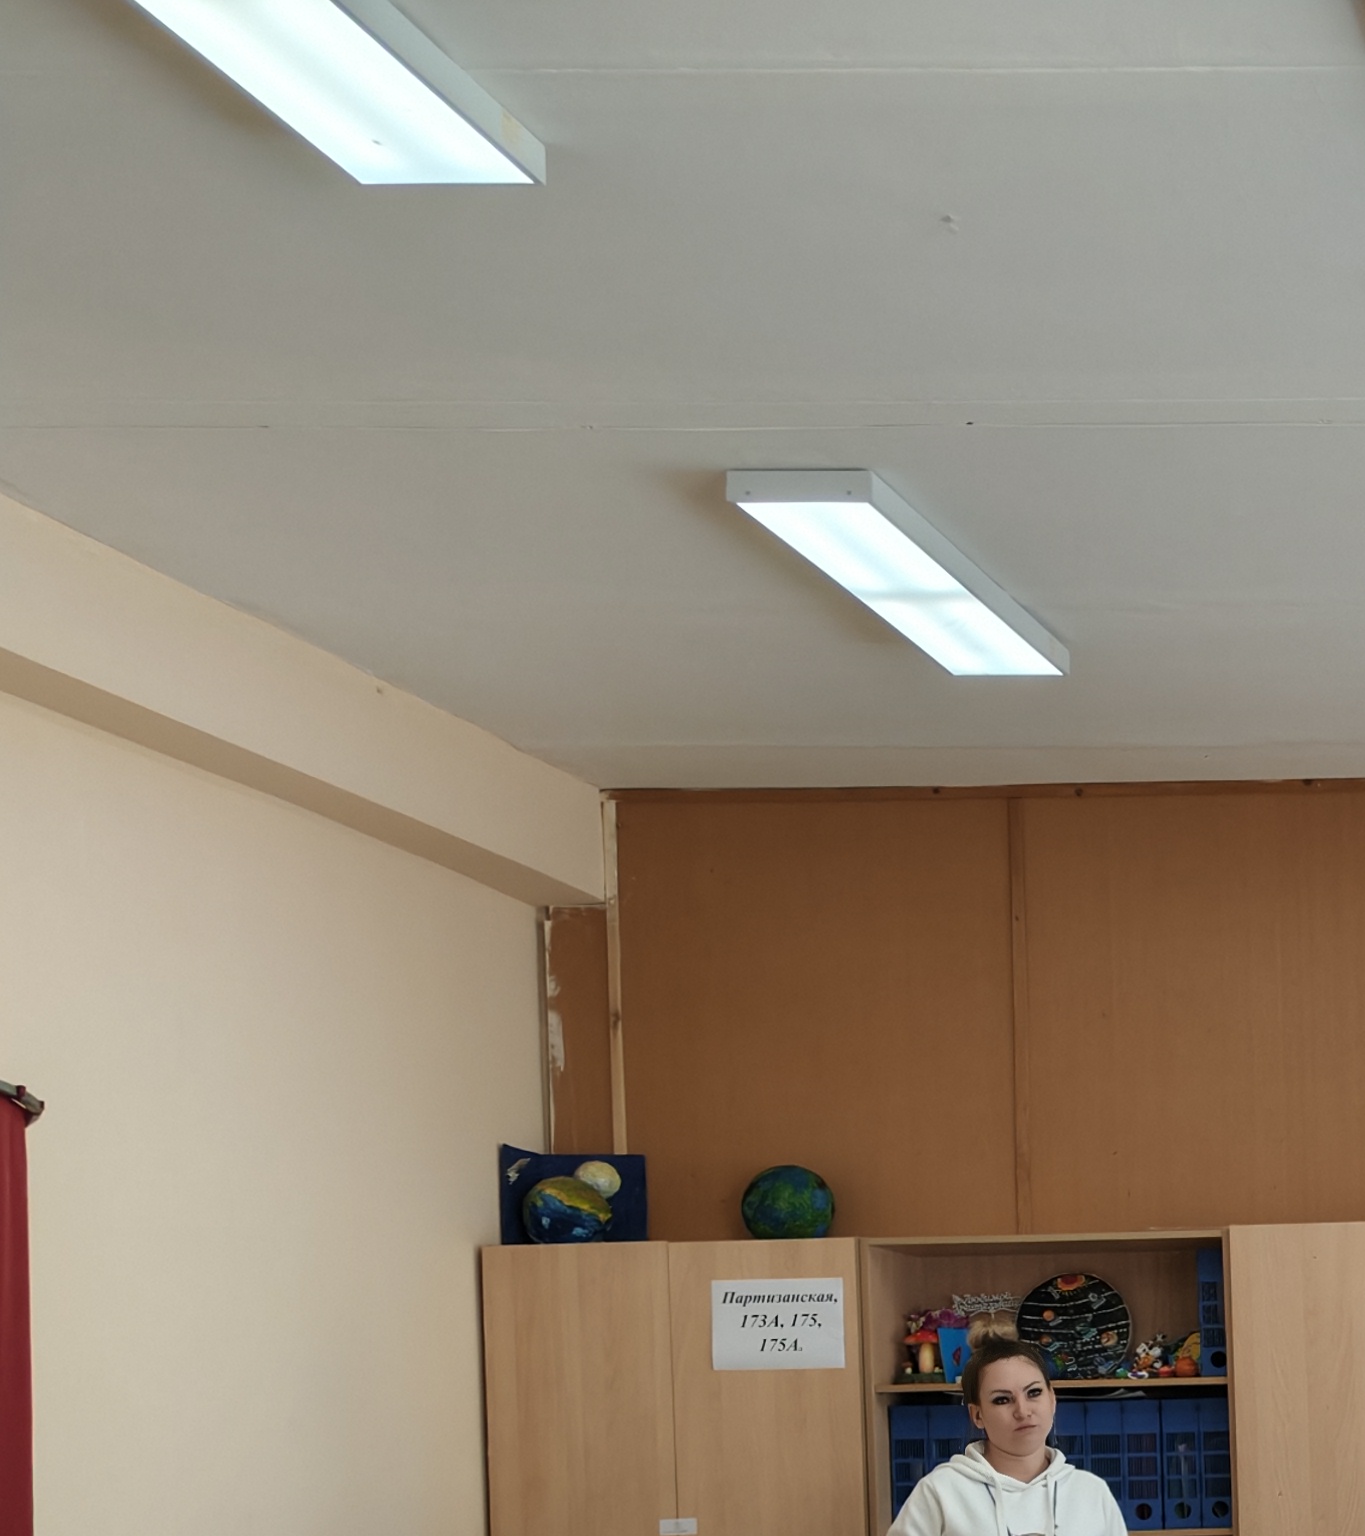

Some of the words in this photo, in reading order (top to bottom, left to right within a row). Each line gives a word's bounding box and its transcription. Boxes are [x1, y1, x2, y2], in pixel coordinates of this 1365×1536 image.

[722, 1291, 838, 1307] Партизанская,
[741, 1313, 784, 1328] 173А,
[791, 1313, 822, 1328] 175,
